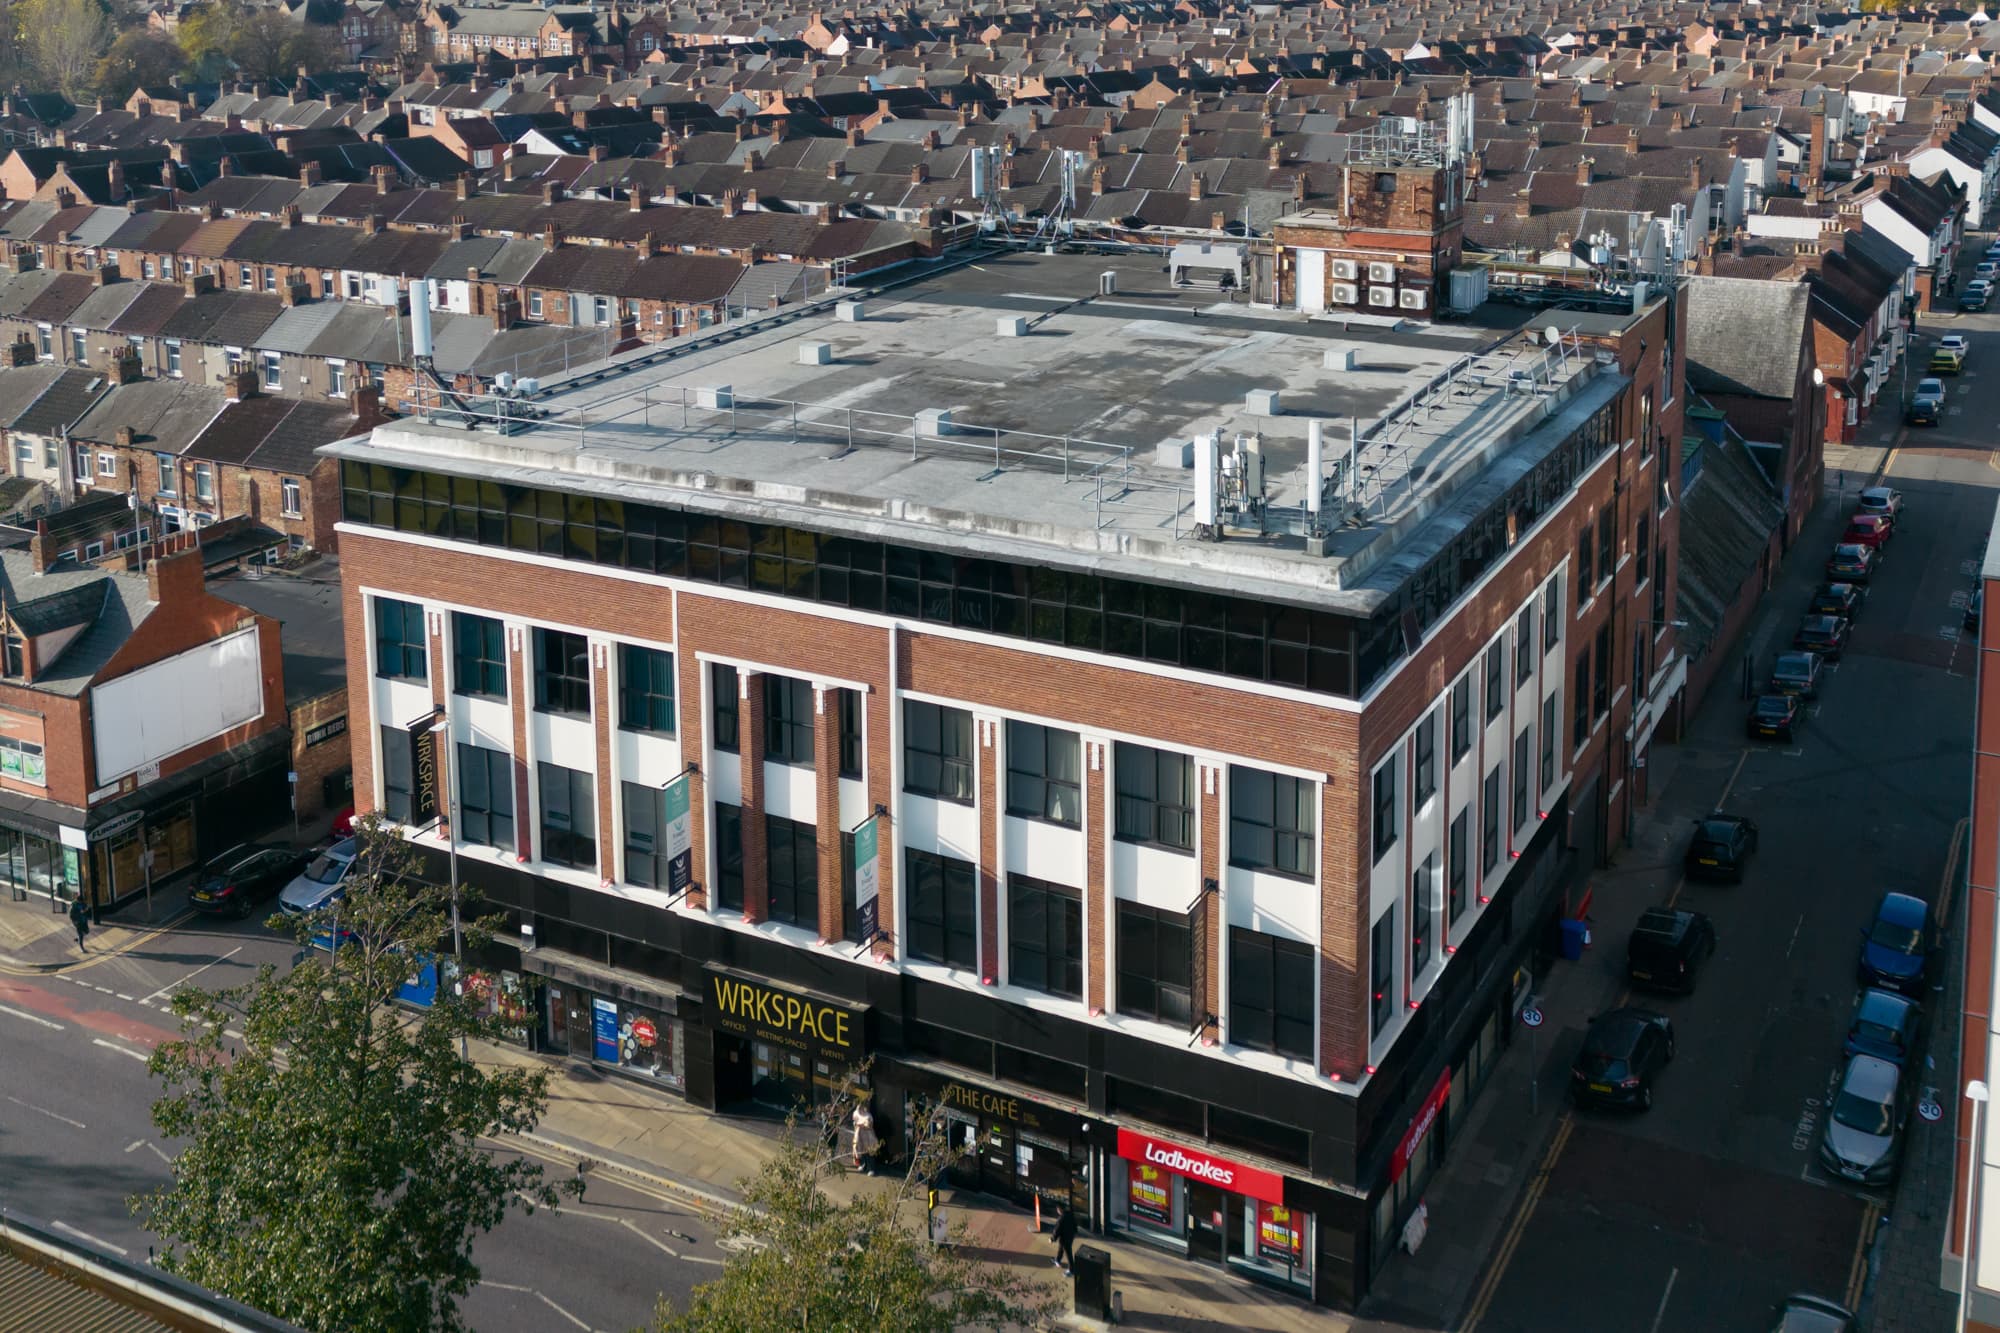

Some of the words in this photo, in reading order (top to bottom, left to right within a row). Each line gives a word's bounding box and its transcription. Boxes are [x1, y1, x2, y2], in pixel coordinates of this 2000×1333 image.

[417, 729, 435, 812] WRKSPACE
[91, 813, 141, 839] FURNITURE
[714, 976, 850, 1047] WRKSPACE
[1524, 1009, 1541, 1022] 30
[721, 1018, 746, 1033] OFFICES
[756, 1028, 783, 1045] MEETING
[784, 1037, 808, 1051] SPACES
[820, 1047, 845, 1061] EVENTS
[952, 1084, 979, 1110] THE
[982, 1094, 1019, 1121] CAFÉ
[1791, 1097, 1821, 1151] DISABLED
[1920, 1103, 1940, 1117] 30
[1145, 1142, 1234, 1185] Ladbrokes
